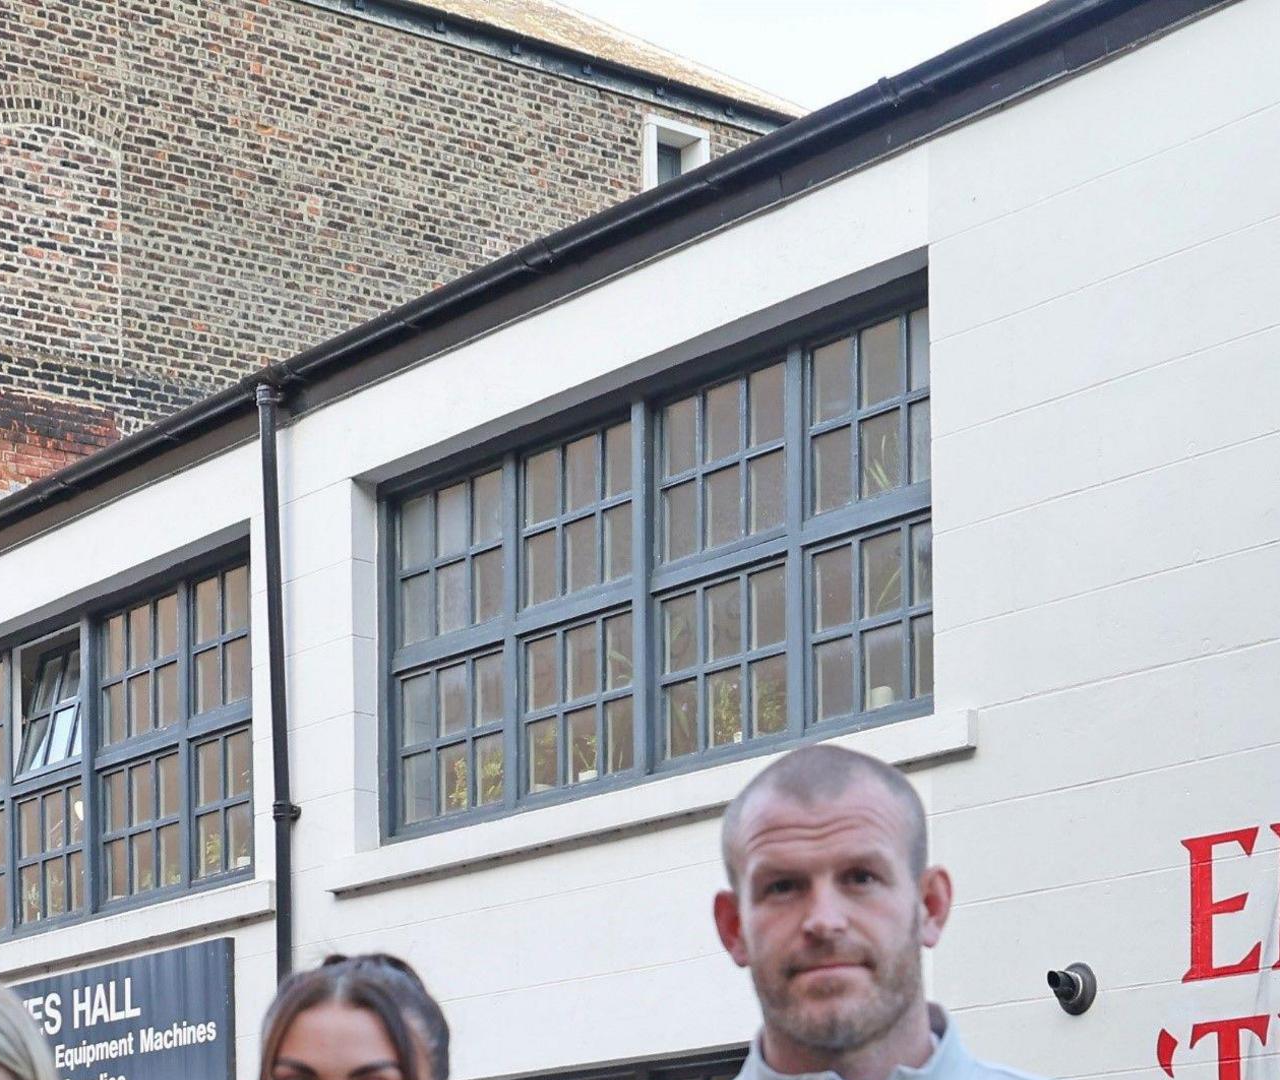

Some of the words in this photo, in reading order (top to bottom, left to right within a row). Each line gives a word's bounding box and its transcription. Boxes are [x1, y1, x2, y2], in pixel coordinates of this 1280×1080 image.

[73, 977, 141, 1029] HALL
[55, 1032, 134, 1069] Equipment
[140, 1020, 216, 1053] Machines
